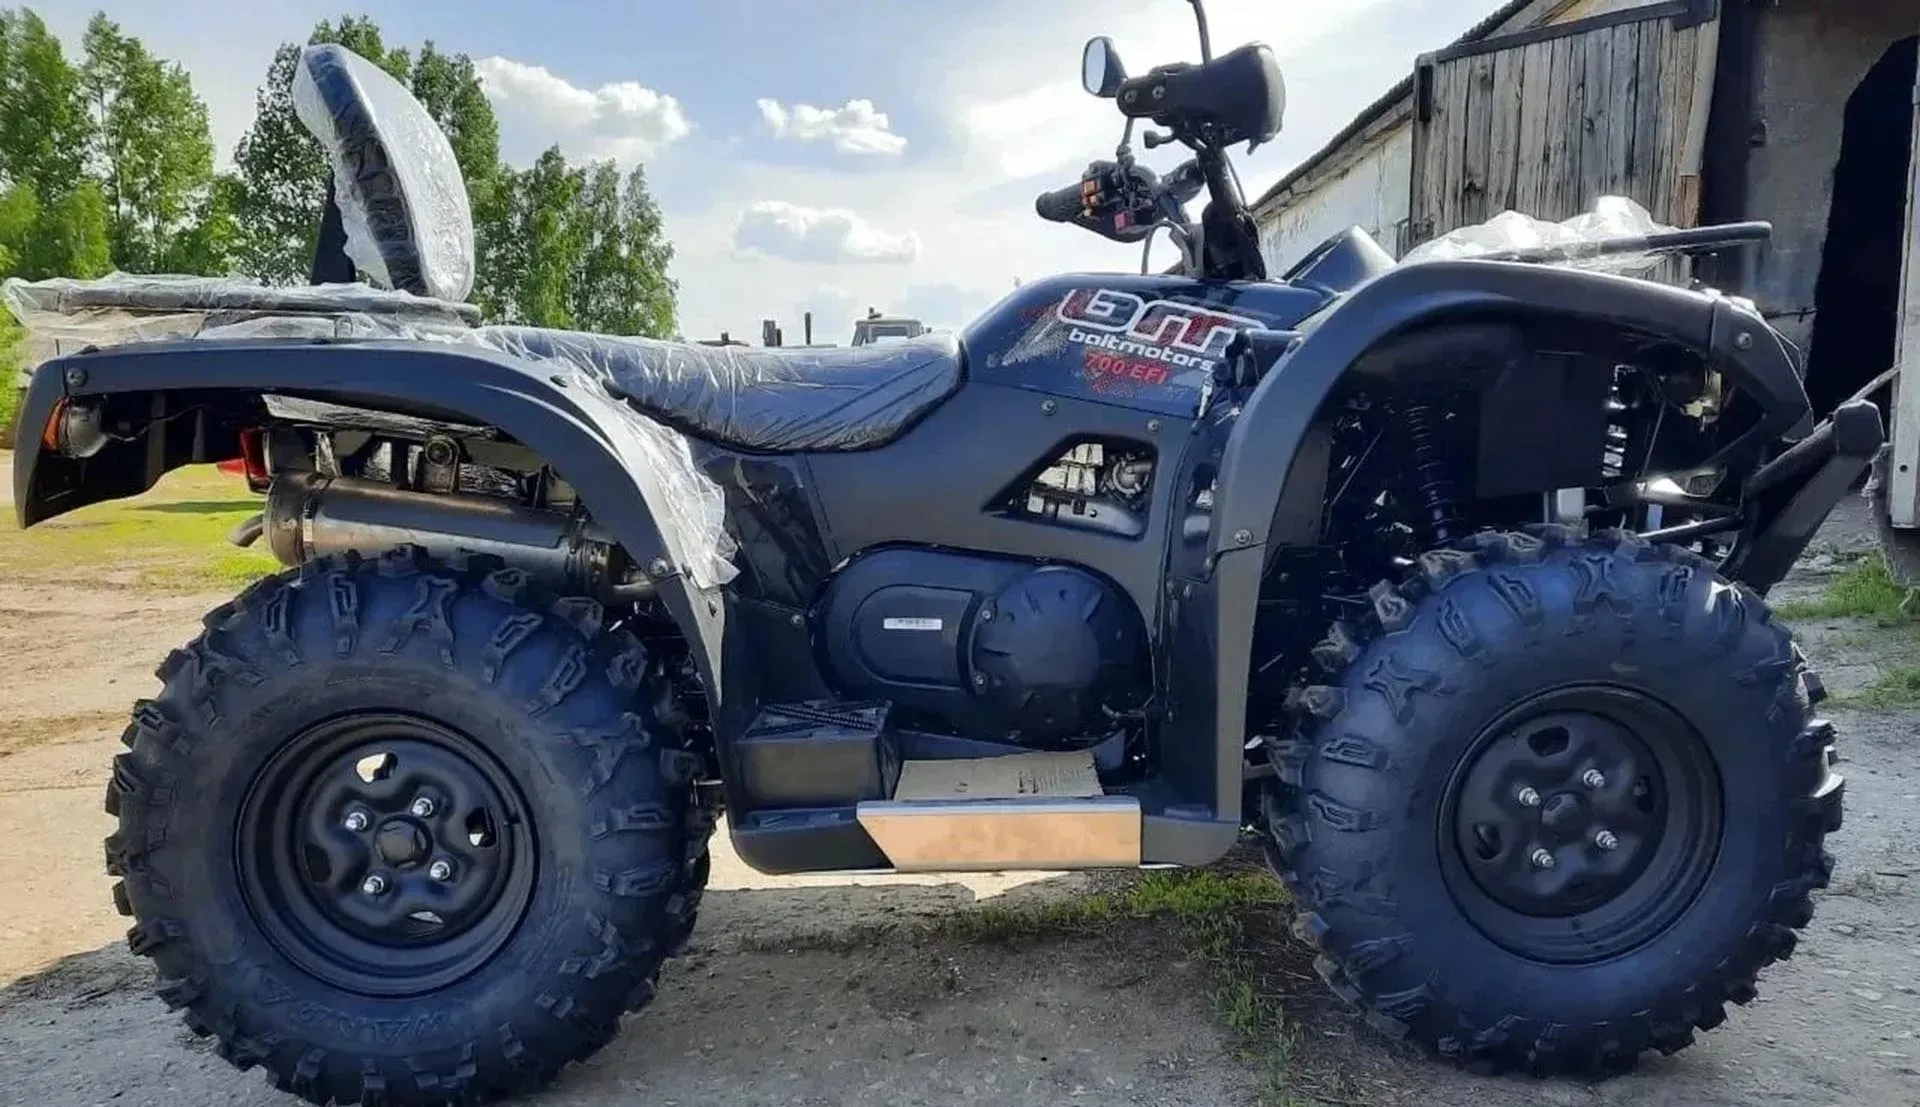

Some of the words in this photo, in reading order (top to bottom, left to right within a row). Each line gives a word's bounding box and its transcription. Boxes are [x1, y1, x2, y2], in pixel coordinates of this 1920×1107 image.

[1068, 327, 1216, 372] boltmotors
[1086, 352, 1126, 375] 700
[1129, 363, 1168, 385] EFI
